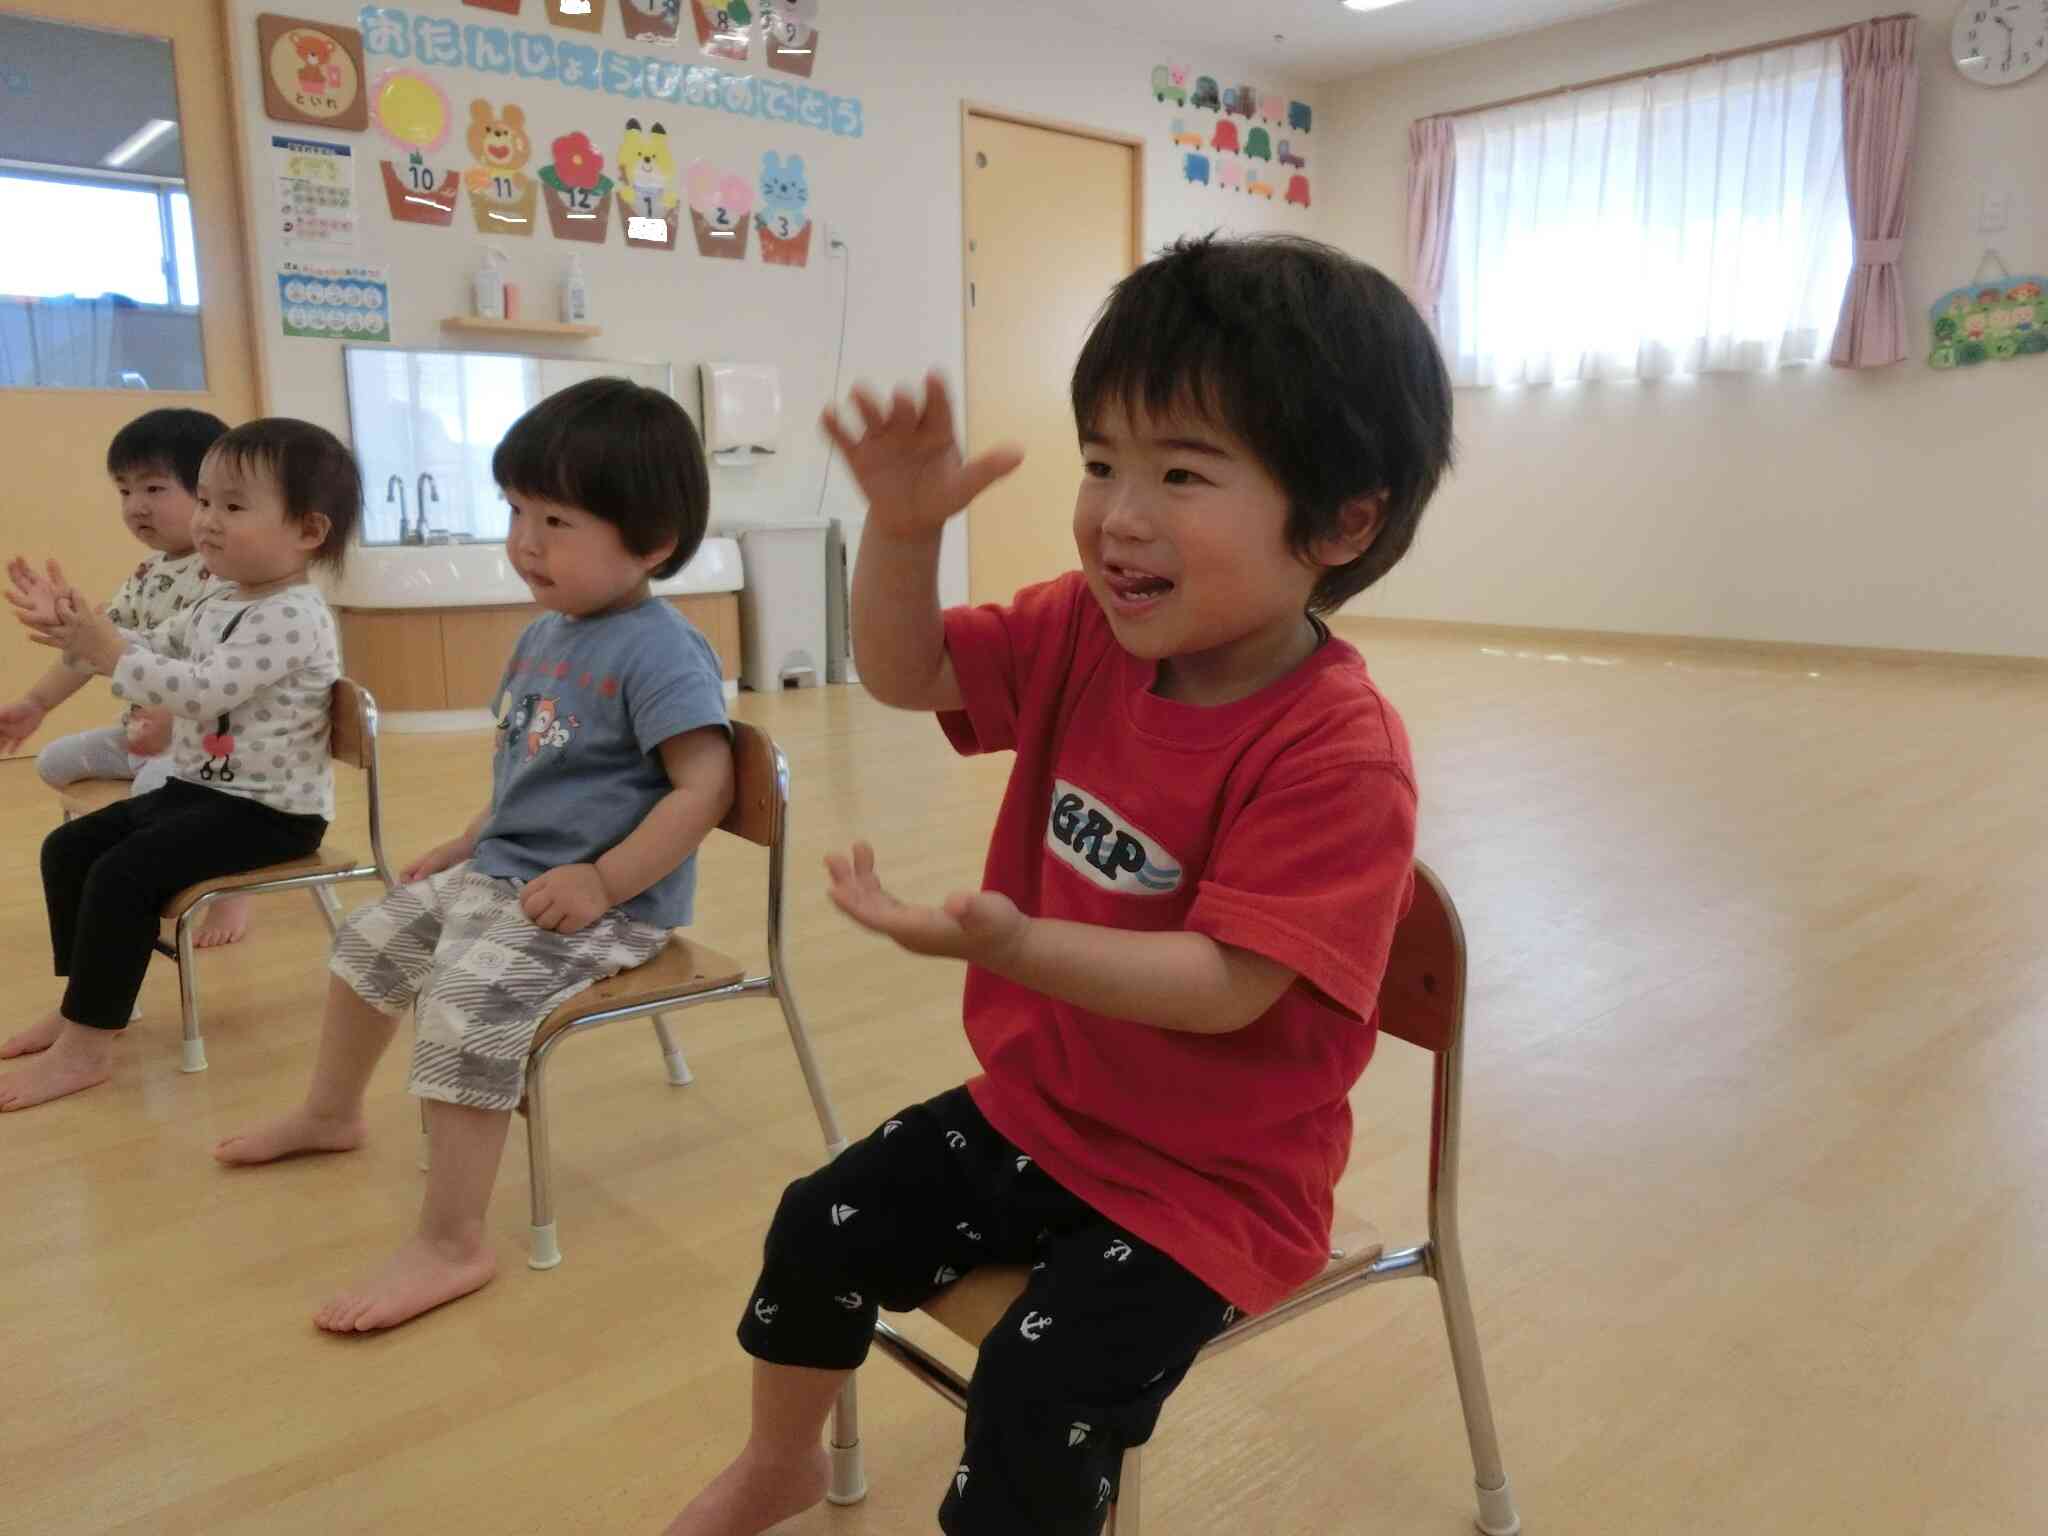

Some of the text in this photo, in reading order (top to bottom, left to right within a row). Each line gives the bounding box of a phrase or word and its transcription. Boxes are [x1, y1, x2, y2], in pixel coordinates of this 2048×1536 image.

[717, 11, 729, 33] 8
[785, 23, 797, 43] 9
[361, 11, 862, 133] おたんじょうびおめでとう
[295, 92, 338, 110] といれ
[408, 166, 434, 191] 10
[493, 176, 512, 198] 11
[567, 188, 591, 208] 12
[643, 197, 654, 218] 1
[716, 207, 730, 225] 2
[777, 216, 790, 238] 3
